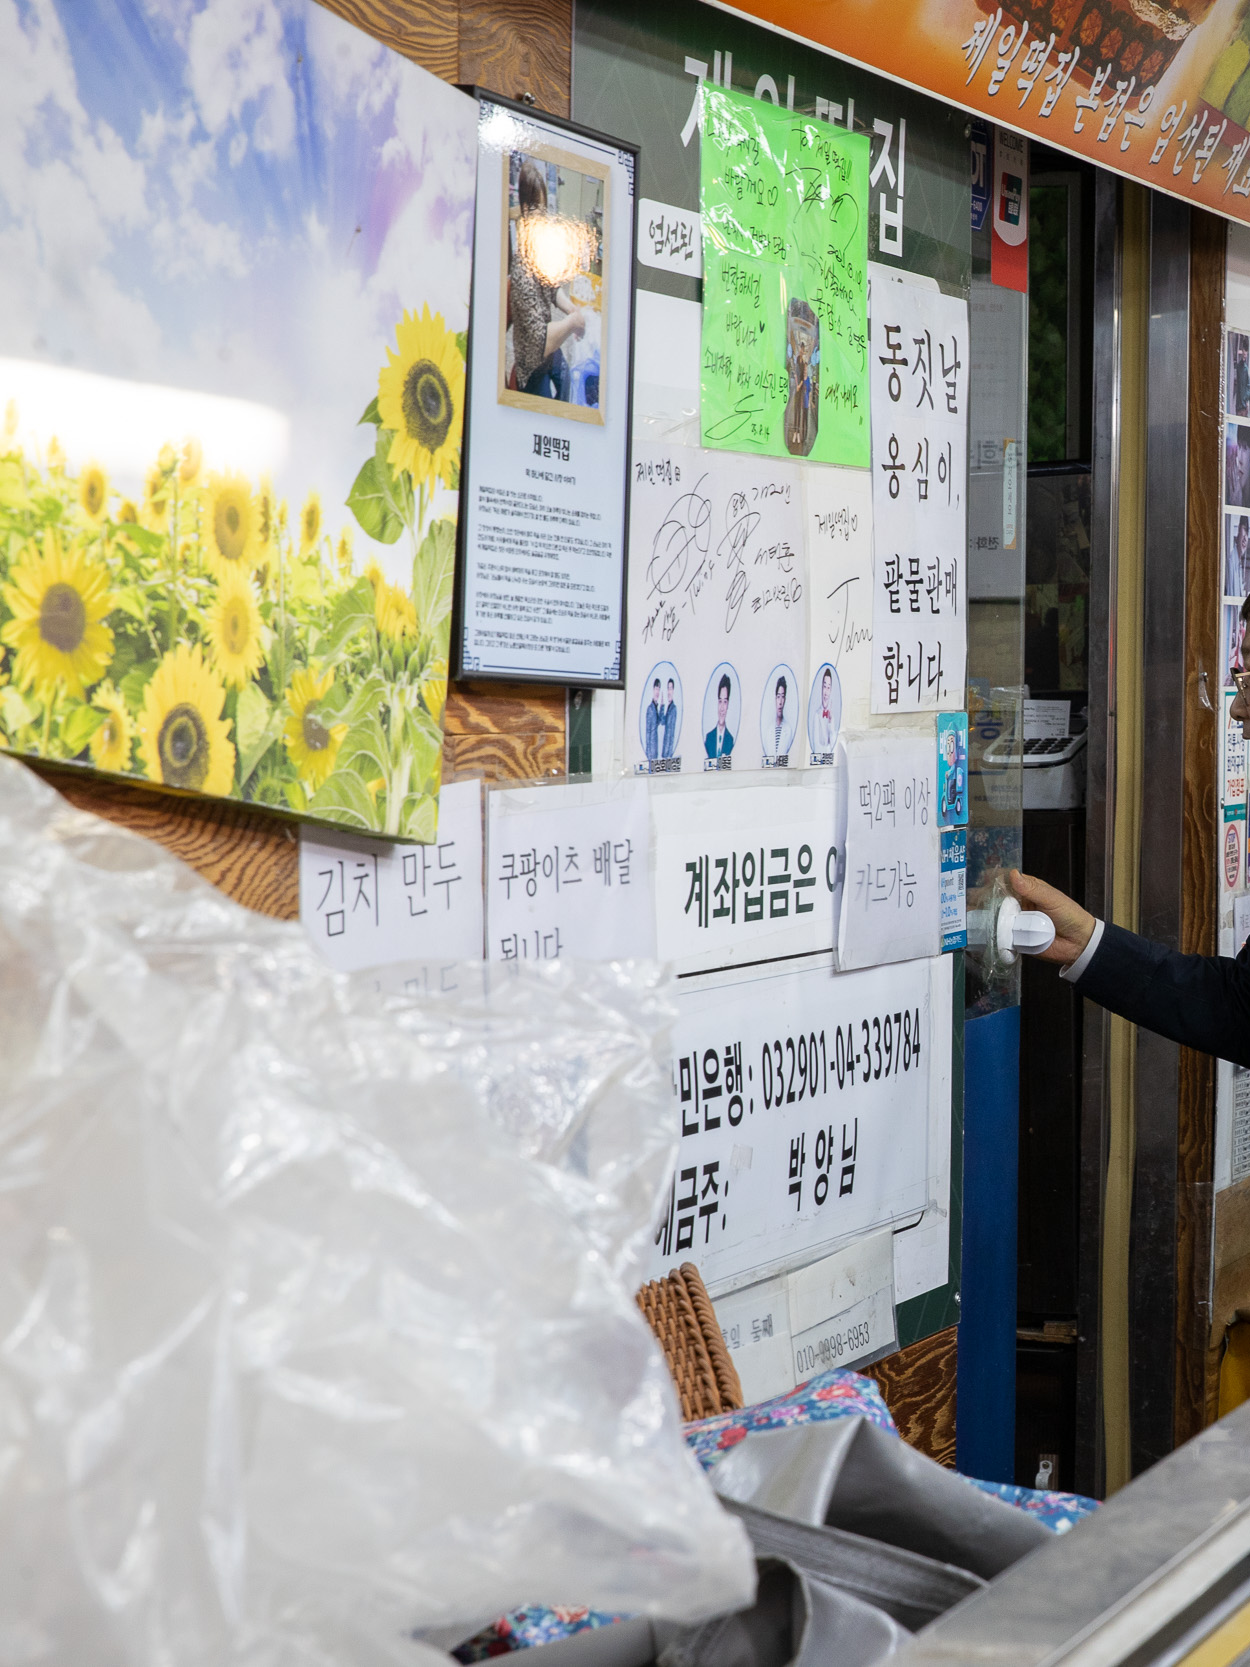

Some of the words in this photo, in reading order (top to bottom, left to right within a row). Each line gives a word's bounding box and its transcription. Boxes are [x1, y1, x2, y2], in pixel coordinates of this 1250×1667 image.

[962, 8, 1080, 117] 제일떡집
[1073, 63, 1155, 151] 본점은
[1149, 100, 1227, 184] 엄선된
[647, 214, 694, 261] 엄선된
[879, 324, 961, 414] 동짓날
[533, 433, 571, 462] 제일떡집
[881, 432, 960, 510] 옹심이,
[883, 552, 957, 617] 팥물판매
[883, 640, 947, 706] 합니다.
[859, 778, 896, 830] 떡2팩
[904, 777, 930, 826] 이상
[317, 852, 378, 937] 김치
[402, 842, 462, 917] 만두
[499, 846, 583, 901] 쿠팡이츠
[593, 839, 633, 887] 배달
[684, 844, 816, 929] 계좌입금은
[855, 860, 917, 912] 카드가능
[672, 1041, 753, 1138] 민은행:
[761, 1006, 921, 1111] 032901-04-339784
[788, 1117, 858, 1213] 박양님
